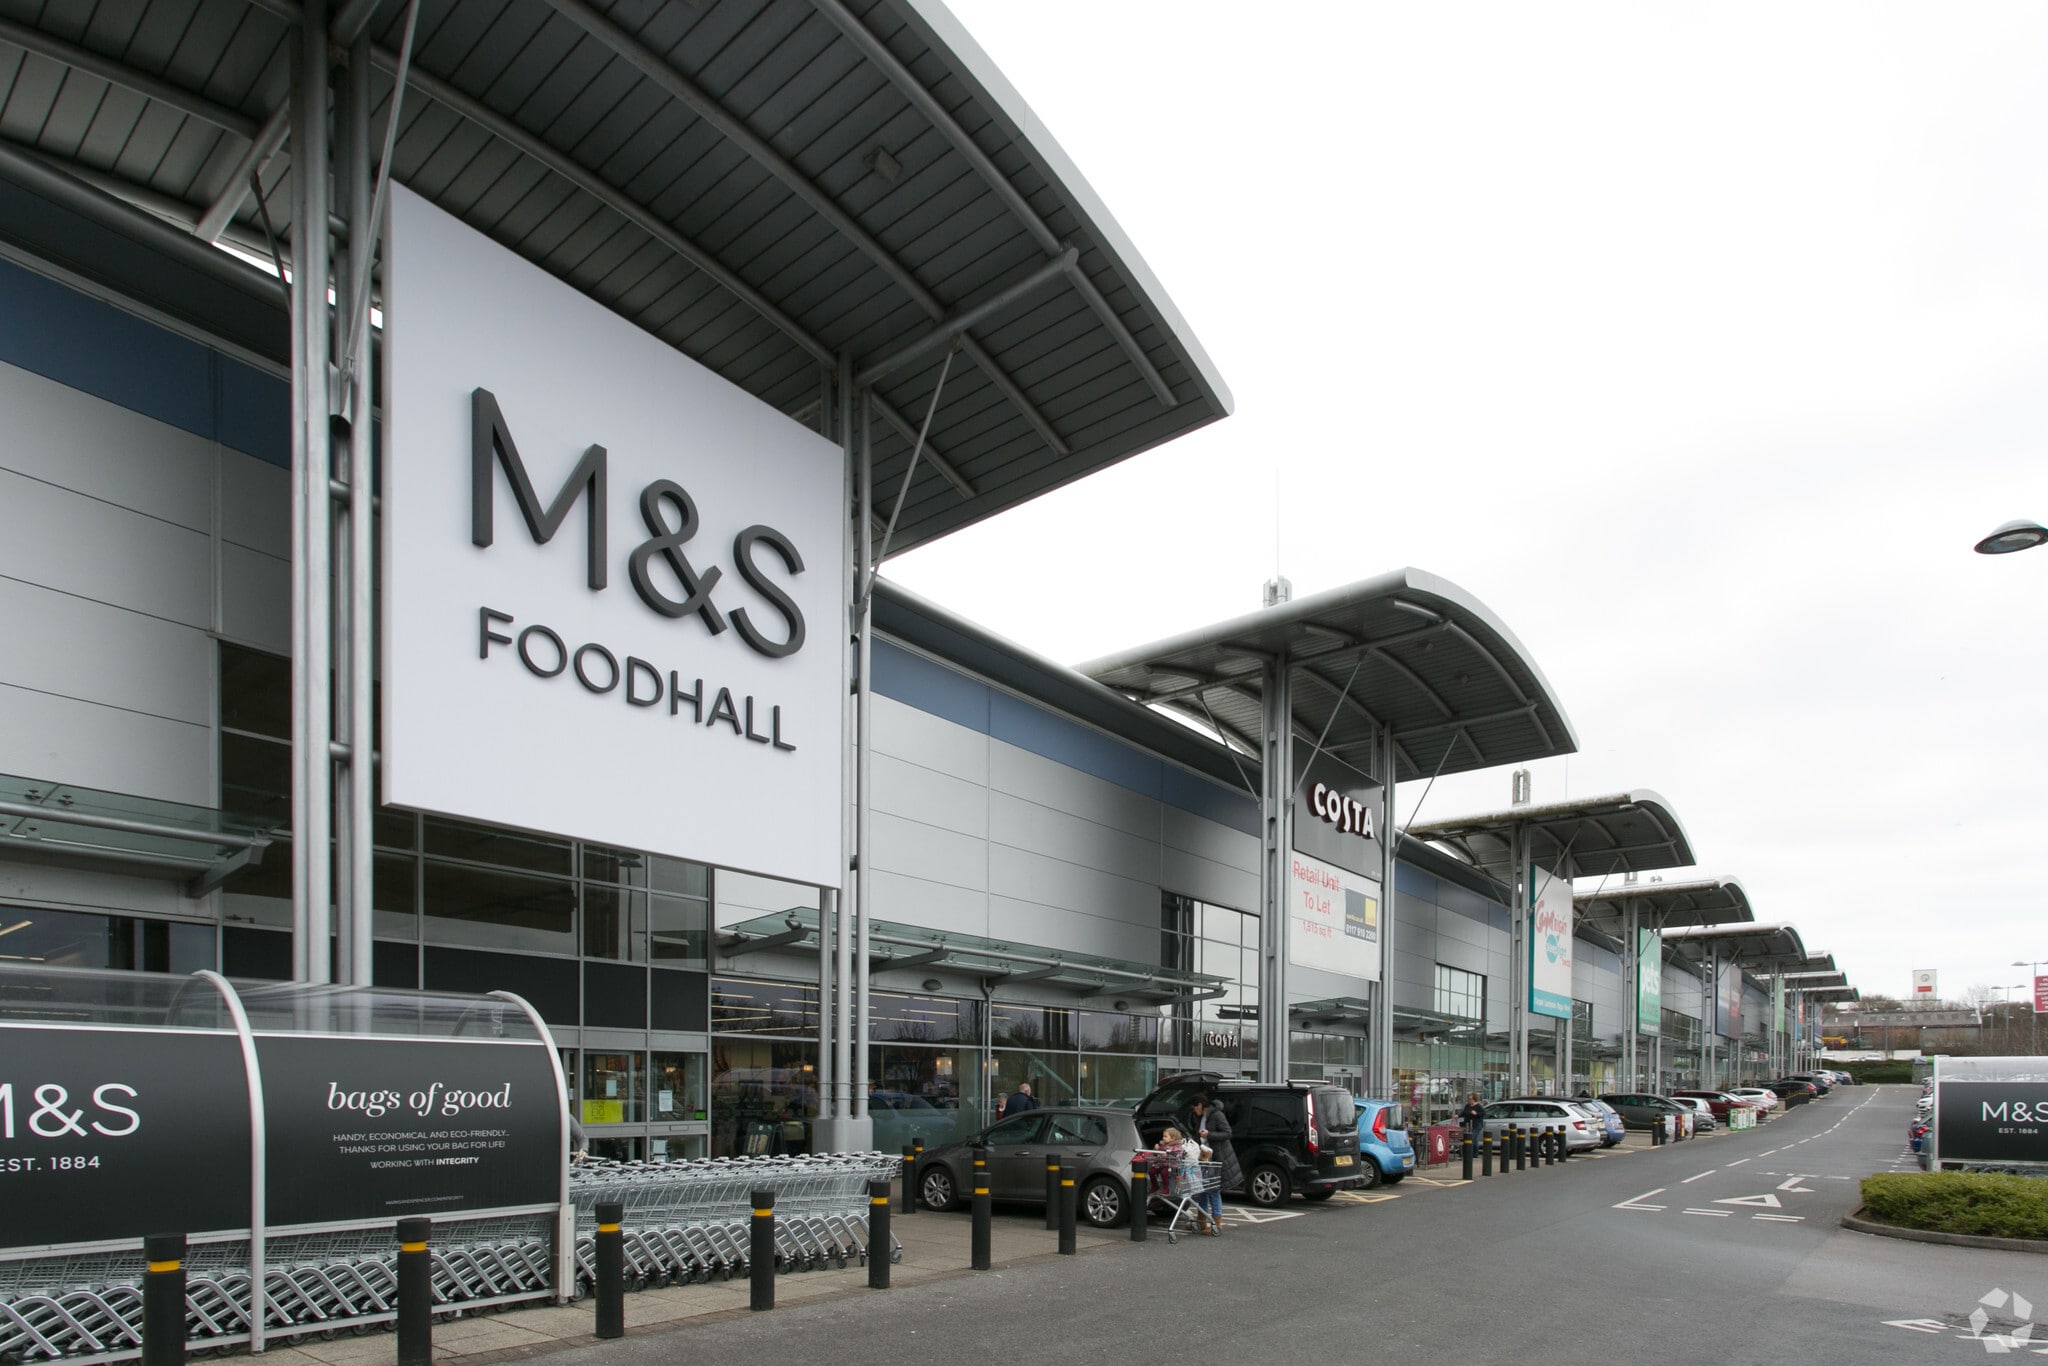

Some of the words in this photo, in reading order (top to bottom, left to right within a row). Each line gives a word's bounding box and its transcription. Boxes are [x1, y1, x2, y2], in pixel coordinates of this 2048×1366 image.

[471, 386, 805, 659] M&S
[479, 605, 796, 752] FOODHALL
[1309, 782, 1375, 839] COSTA
[1292, 860, 1319, 886] Retail
[1322, 871, 1340, 892] Unit
[1303, 890, 1314, 910] To
[1316, 895, 1331, 916] Let
[1208, 1033, 1239, 1048] COSTA
[0, 1083, 140, 1138] &S
[327, 1081, 401, 1118] bags
[408, 1081, 444, 1117] of
[441, 1082, 512, 1117] good
[1982, 1101, 2048, 1123] M&S
[333, 1133, 368, 1142] HANDY,
[369, 1131, 428, 1141] ECONOMICAL
[429, 1130, 449, 1139] AND
[339, 1145, 376, 1154] THANKS
[377, 1144, 396, 1153] FOR
[398, 1143, 425, 1152] USING
[426, 1142, 451, 1151] YOUR
[451, 1141, 469, 1150] BAG
[470, 1141, 487, 1149] FOR
[50, 1155, 101, 1170] 1884
[370, 1159, 412, 1169] WORKING
[413, 1158, 435, 1167] WITH
[435, 1156, 480, 1166] INTEGRITY
